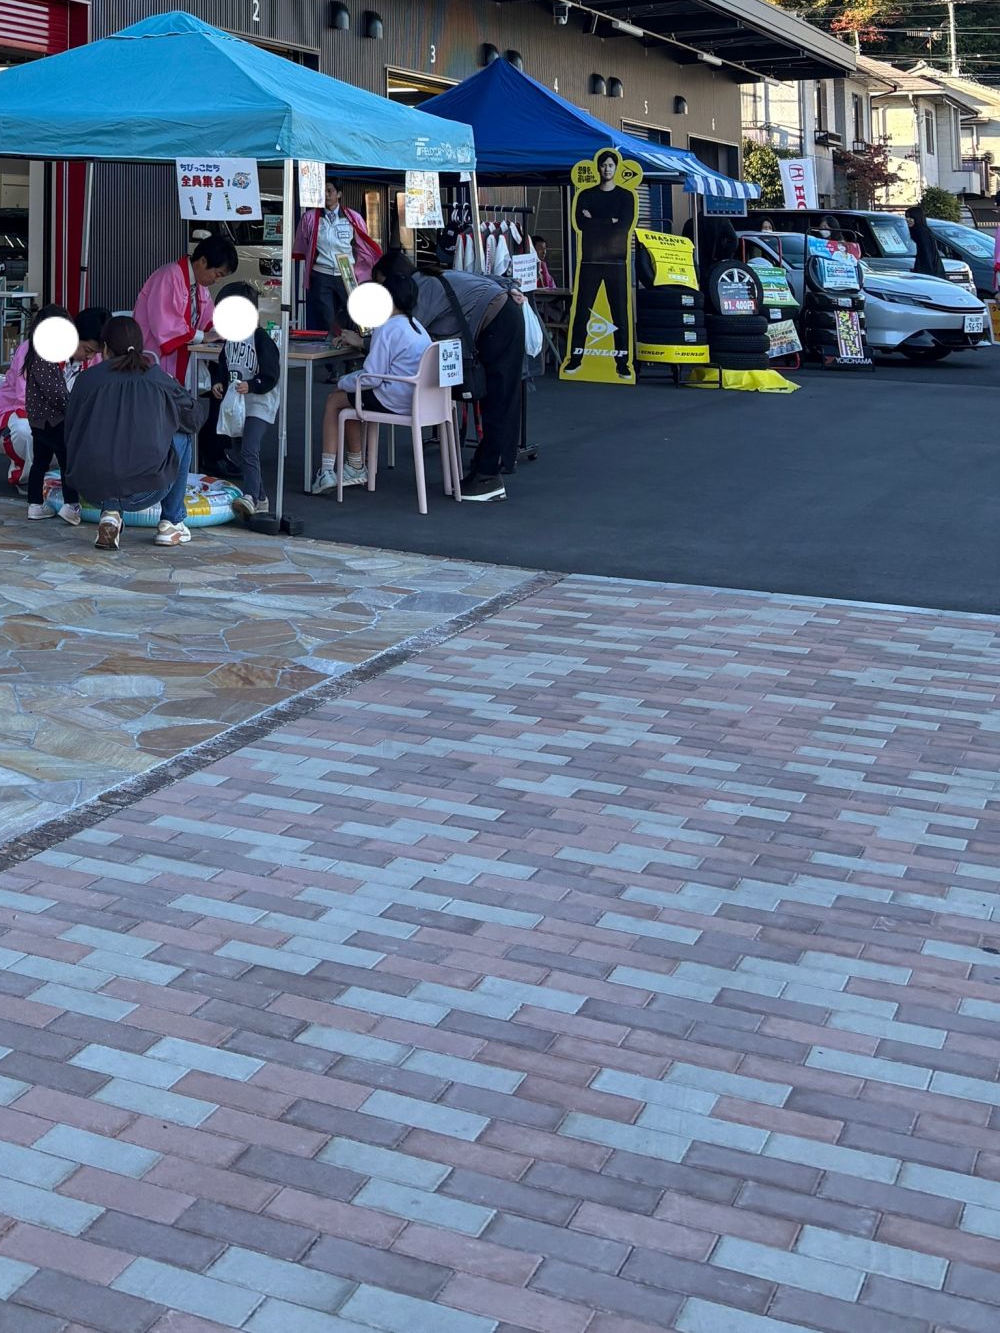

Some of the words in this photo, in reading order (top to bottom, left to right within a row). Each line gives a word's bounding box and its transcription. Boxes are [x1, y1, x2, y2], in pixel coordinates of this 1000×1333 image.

[252, 0, 260, 21] 2
[430, 45, 436, 63] 3
[553, 77, 559, 93] 4
[644, 100, 648, 114] 5
[180, 163, 220, 172] ちびっこたち
[573, 347, 628, 357] DUNLOP
